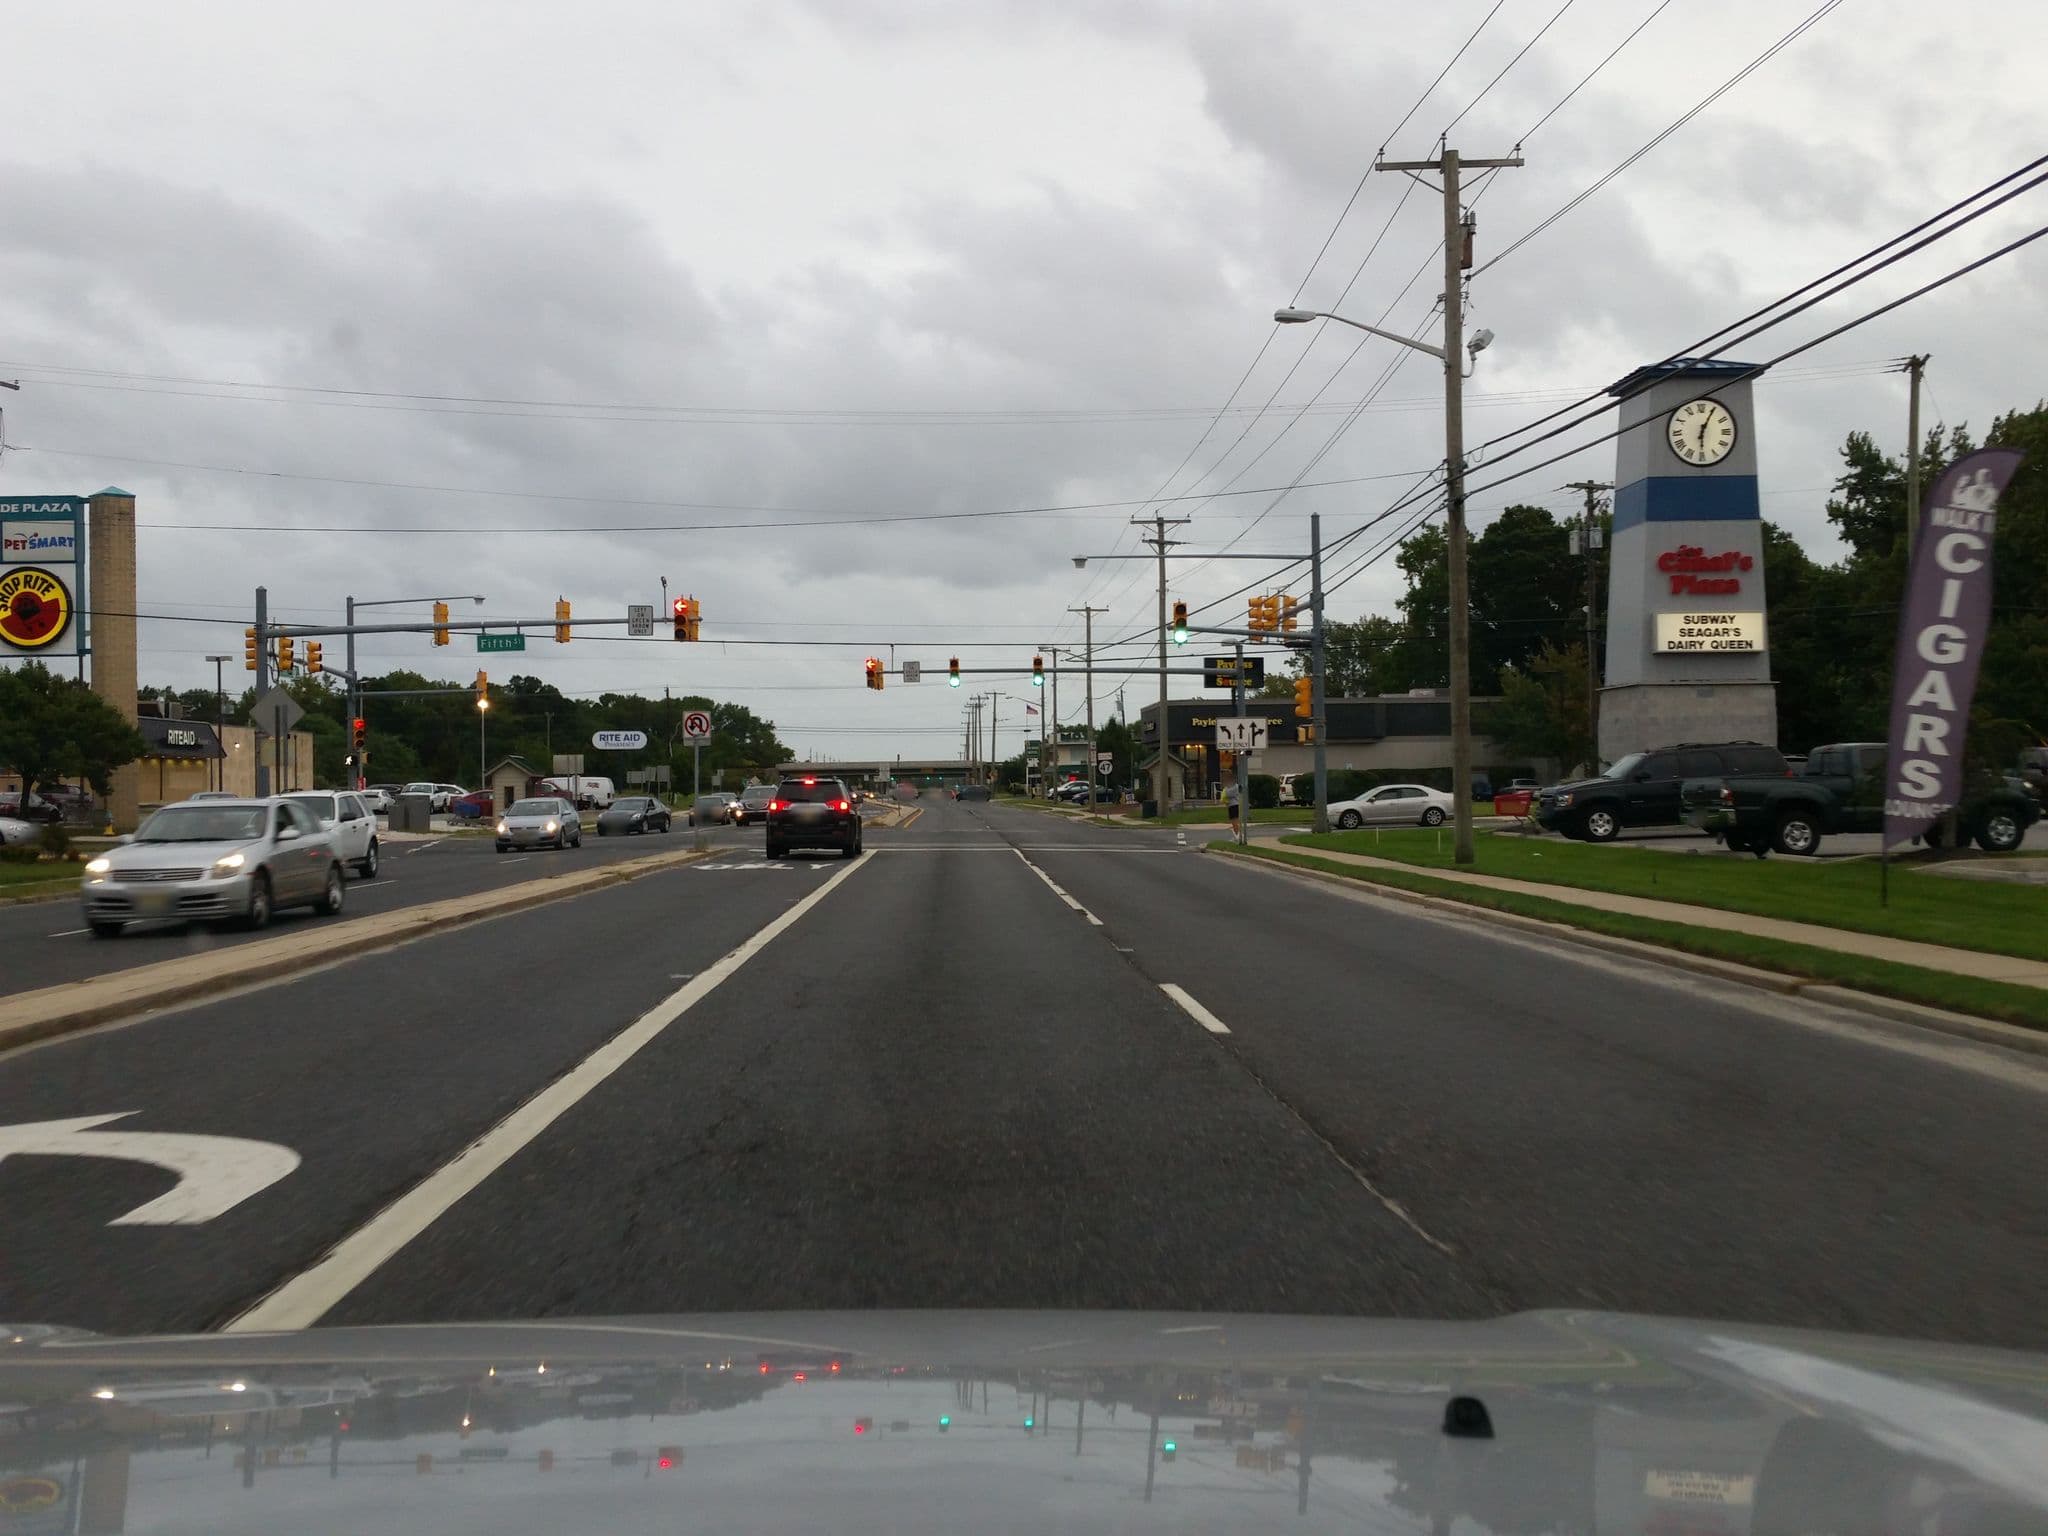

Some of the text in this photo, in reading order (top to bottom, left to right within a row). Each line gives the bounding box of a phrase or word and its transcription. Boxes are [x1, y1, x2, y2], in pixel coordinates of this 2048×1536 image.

[23, 503, 72, 512] PLAZA
[23, 574, 56, 597] RITE
[1683, 615, 1737, 625] SUBWAY
[1679, 627, 1741, 638] SEAGAR'S
[481, 638, 512, 649] Fifth
[1667, 640, 1753, 650] DAIRY QUEEN
[1216, 659, 1254, 669] Paylss
[1897, 532, 1986, 799] CIGARS
